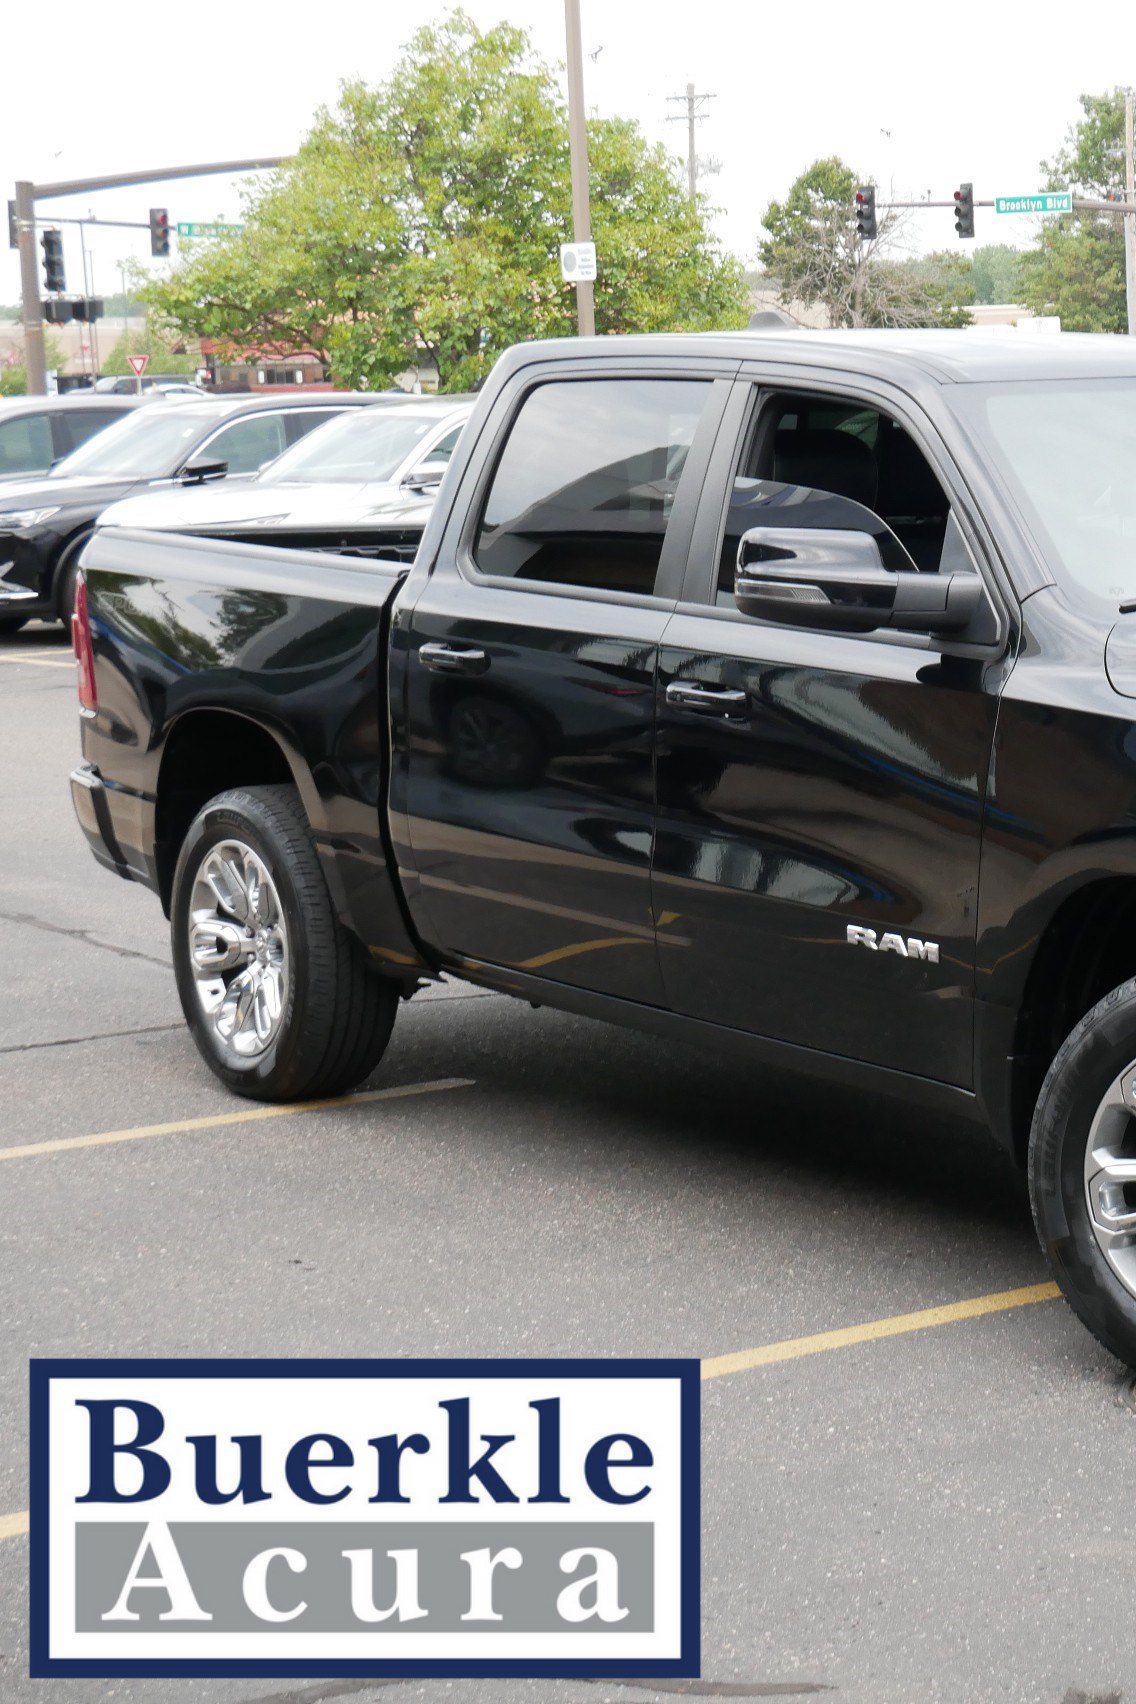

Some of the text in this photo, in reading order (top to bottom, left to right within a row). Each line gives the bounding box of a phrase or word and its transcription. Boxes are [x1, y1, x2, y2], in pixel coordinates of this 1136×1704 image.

[999, 196, 1068, 212] Brooklyn Blvd
[846, 924, 940, 964] RAM
